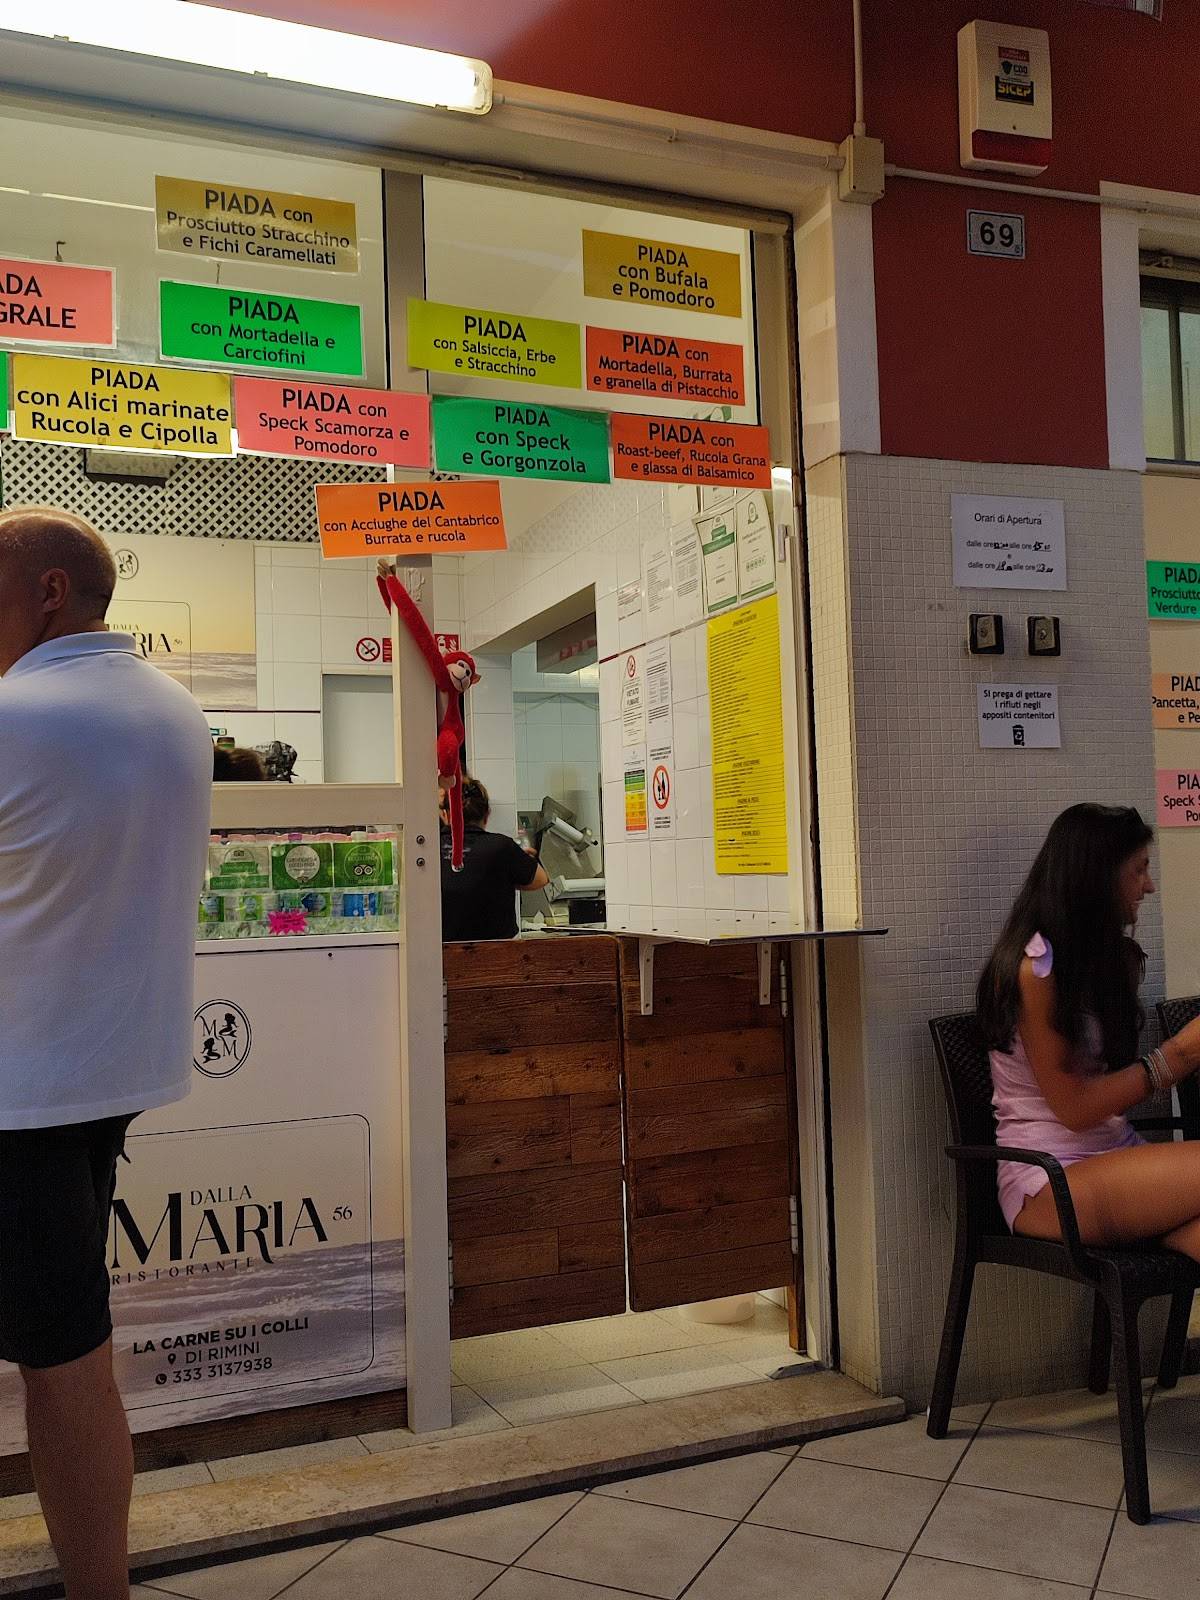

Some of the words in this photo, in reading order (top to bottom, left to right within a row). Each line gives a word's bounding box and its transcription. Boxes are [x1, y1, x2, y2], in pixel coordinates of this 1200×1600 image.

[204, 189, 276, 218] PIADA
[283, 209, 313, 224] con
[167, 211, 256, 237] Prosciutto
[262, 225, 350, 249] Stracchino
[980, 221, 1014, 247] 69
[183, 236, 193, 247] e
[199, 235, 240, 254] Fichi
[245, 241, 337, 266] Caramellati
[638, 244, 689, 268] PIADA
[618, 264, 649, 281] con
[655, 266, 708, 290] Bufala
[612, 283, 623, 296] e
[630, 282, 715, 309] Pomodoro
[229, 297, 300, 324] PIADA
[191, 321, 222, 337] con
[229, 325, 319, 348] Mortadella
[325, 337, 336, 349] e
[464, 315, 527, 342] PIADA
[223, 343, 305, 365] Carciofini
[433, 337, 457, 351] con
[462, 340, 521, 360] Salsiccia,
[526, 349, 556, 364] Erbe
[622, 334, 679, 359] PIADA
[685, 348, 709, 362] con
[454, 358, 463, 368] e
[467, 357, 536, 377] Stracchino
[599, 357, 677, 378] Mortadella,
[683, 365, 733, 384] Burrata
[91, 368, 160, 392] PIADA
[593, 375, 602, 386] e
[606, 373, 657, 394] granella
[661, 379, 673, 393] di
[677, 381, 739, 400] Pistacchio
[17, 390, 59, 407] con
[67, 391, 118, 413] Alici
[127, 399, 230, 421] marinate
[282, 389, 351, 414] PIADA
[358, 404, 387, 418] con
[259, 413, 308, 432] Speck
[315, 417, 393, 440] Scamorza
[400, 429, 409, 440] e
[495, 406, 551, 427] PIADA
[31, 412, 110, 437] Rucola
[119, 423, 133, 438] e
[142, 423, 218, 447] Cipolla
[475, 429, 509, 446] con
[516, 431, 571, 452] Speck
[649, 422, 705, 447] PIADA
[710, 435, 735, 448] con
[295, 436, 377, 457] Pomodoro
[617, 443, 685, 463] Roast-beef,
[690, 450, 728, 467] Rucola
[733, 452, 767, 467] Grana
[462, 451, 473, 465] e
[481, 450, 586, 474] Gorgonzola
[631, 462, 639, 472] e
[643, 460, 677, 478] glassa
[682, 462, 693, 477] di
[697, 464, 755, 482] Balsamico
[378, 491, 445, 512] PIADA
[324, 520, 347, 532] con
[351, 517, 407, 532] Acciughe
[412, 517, 430, 528] del
[435, 514, 499, 528] Cantabrico
[975, 513, 995, 522] Orari
[997, 515, 1005, 523] di
[1007, 514, 1042, 526] Apertura
[365, 532, 412, 545] Burrata
[417, 534, 425, 542] e
[428, 530, 466, 542] rucola
[1156, 602, 1197, 614] Verdure
[993, 691, 1013, 700] prega
[1016, 690, 1022, 698] di
[1025, 691, 1052, 700] gettare
[1023, 701, 1041, 710] negli
[982, 711, 1012, 720] appositi
[1014, 711, 1055, 719] contenitori
[1178, 714, 1185, 723] e
[1164, 794, 1195, 810] Speck
[1186, 810, 1200, 822] Po
[190, 1184, 252, 1206] DALLA
[110, 1191, 329, 1270] MARIA
[332, 1206, 353, 1222] 56
[111, 1257, 255, 1286] RISTORANTE
[132, 1341, 156, 1355] LA
[161, 1329, 221, 1350] CARNE
[224, 1326, 247, 1340] SU
[251, 1324, 257, 1337] I
[261, 1317, 309, 1334] COLLI
[185, 1350, 202, 1364] DI
[208, 1341, 260, 1360] RIMINI
[172, 1367, 202, 1384] 333
[207, 1356, 273, 1379] 3137938
